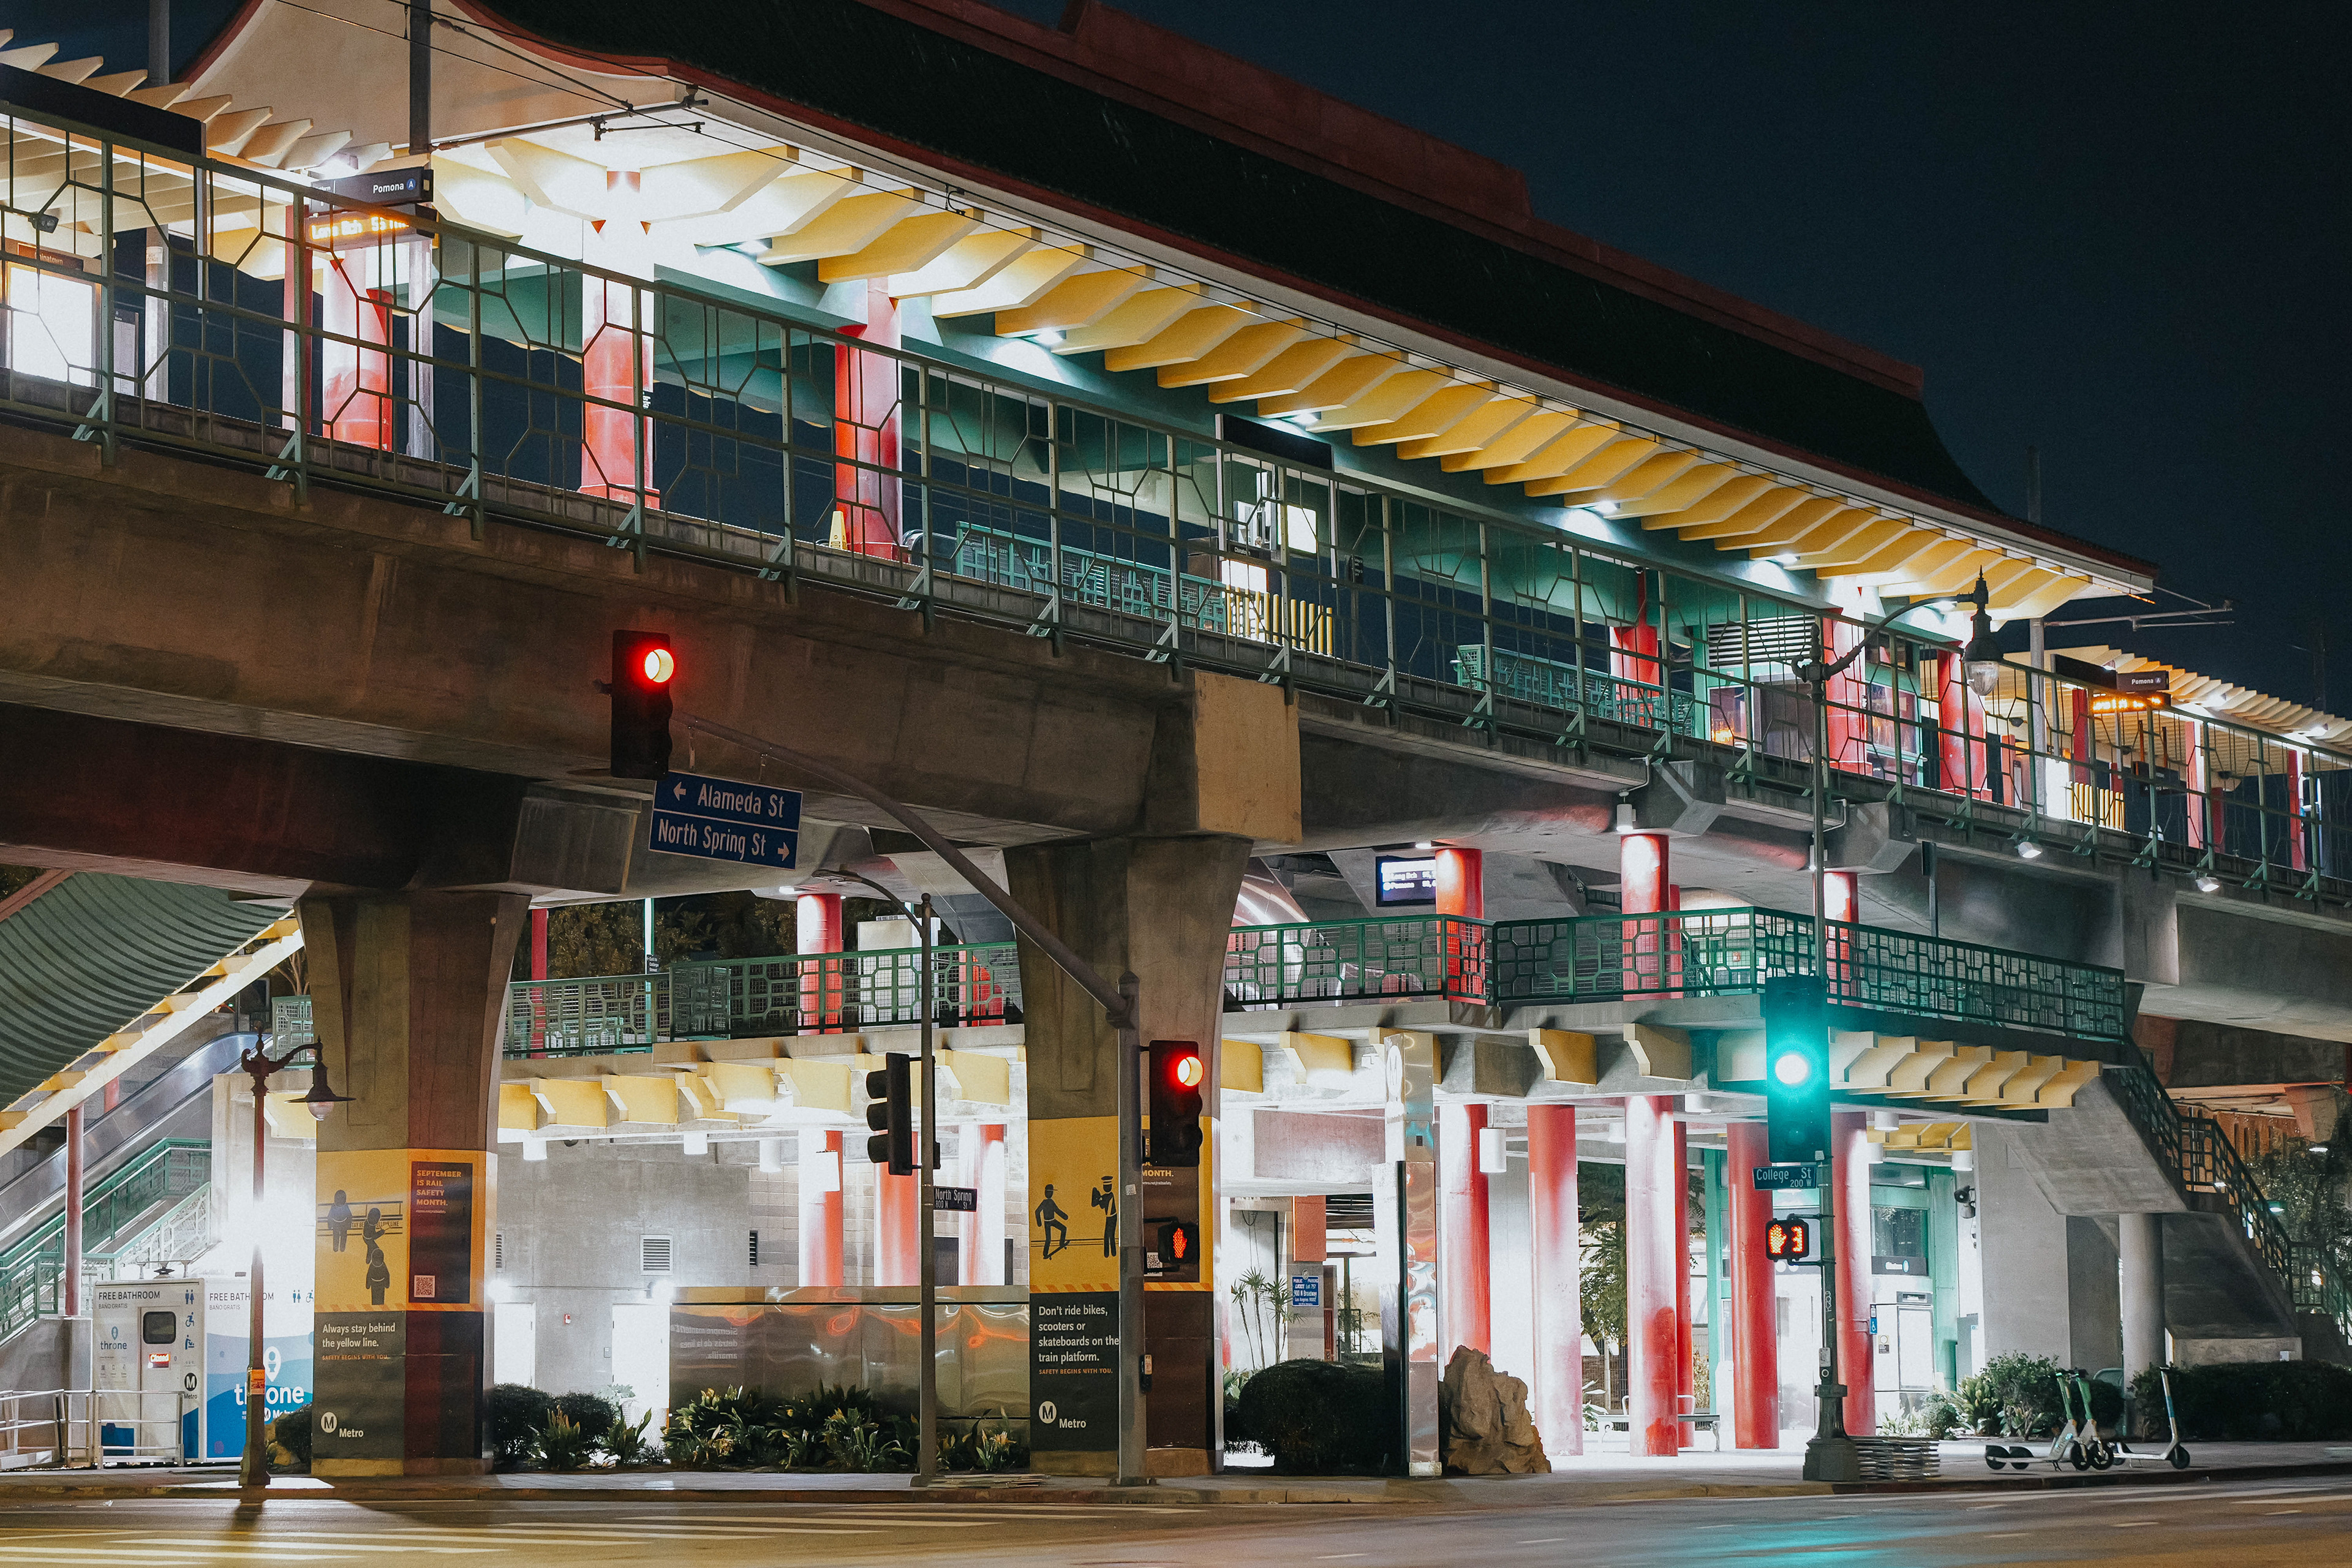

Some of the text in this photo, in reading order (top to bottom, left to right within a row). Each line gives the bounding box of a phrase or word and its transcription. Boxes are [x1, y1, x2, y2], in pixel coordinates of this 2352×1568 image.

[372, 183, 404, 194] Pomona
[1234, 546, 1251, 556] Chinaton
[697, 783, 785, 818] Alameda St
[658, 818, 766, 861] North Spring St
[1757, 1167, 1812, 1183] College St
[1790, 1178, 1812, 1188] 200 W
[935, 1188, 972, 1205] North Spring
[963, 1201, 968, 1210] St
[1791, 1226, 1804, 1253] 3
[99, 1291, 160, 1300] FREE BATHROOM
[1038, 1304, 1108, 1316] Don't ride bikes,
[322, 1322, 396, 1336] Always stay behind
[1038, 1322, 1074, 1331] scooters
[100, 1341, 127, 1350] throne
[322, 1337, 379, 1350] the yellow line.
[1038, 1335, 1090, 1347] skateboards
[1106, 1335, 1119, 1345] the
[1038, 1351, 1099, 1365] train platform.
[234, 1382, 304, 1406] tone
[1059, 1418, 1087, 1428] Metro
[339, 1428, 364, 1438] Metro
